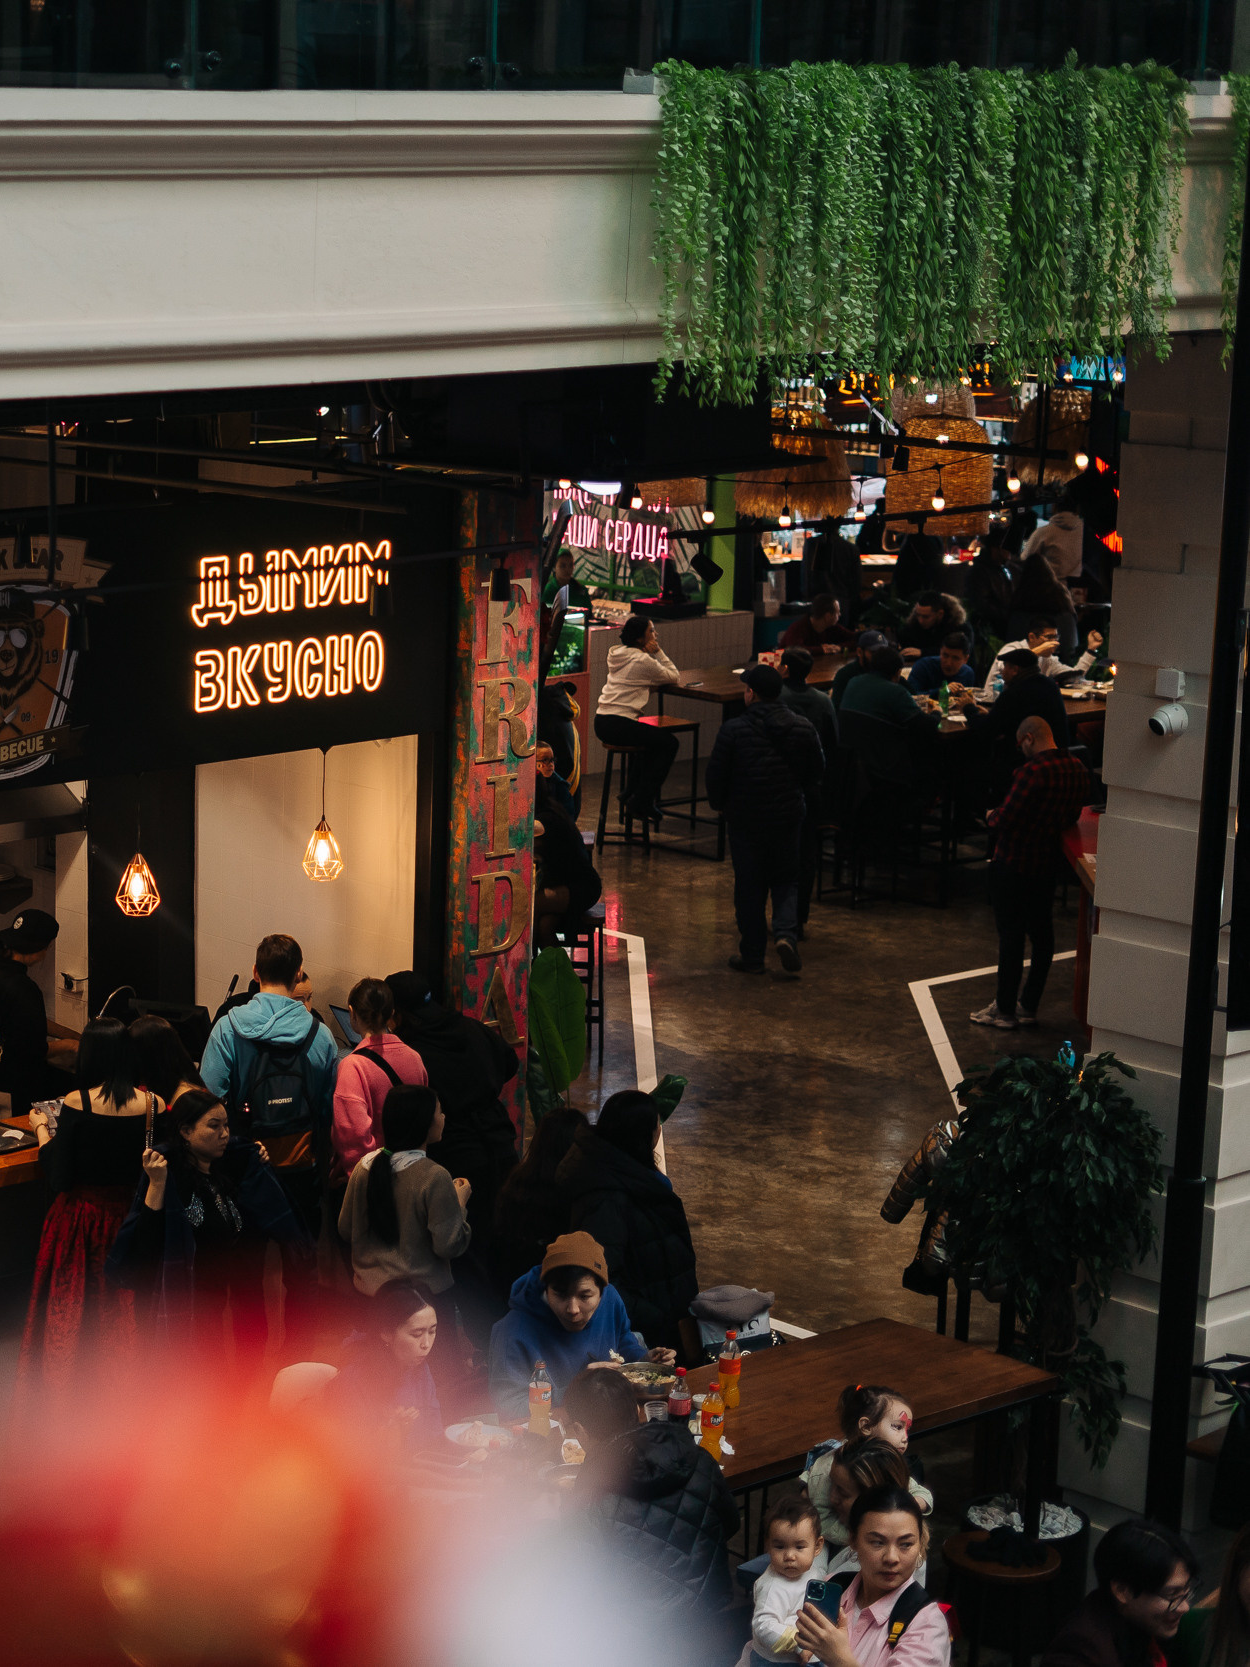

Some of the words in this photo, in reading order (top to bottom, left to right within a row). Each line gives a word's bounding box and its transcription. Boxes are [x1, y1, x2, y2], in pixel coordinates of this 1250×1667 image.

[552, 511, 599, 549] АШИ
[604, 517, 669, 563] СЕРДЦА
[190, 539, 392, 628] ДЫМИМ
[45, 649, 59, 664] 19
[194, 630, 386, 714] ВКУСНО
[469, 577, 536, 1045] FRIDA
